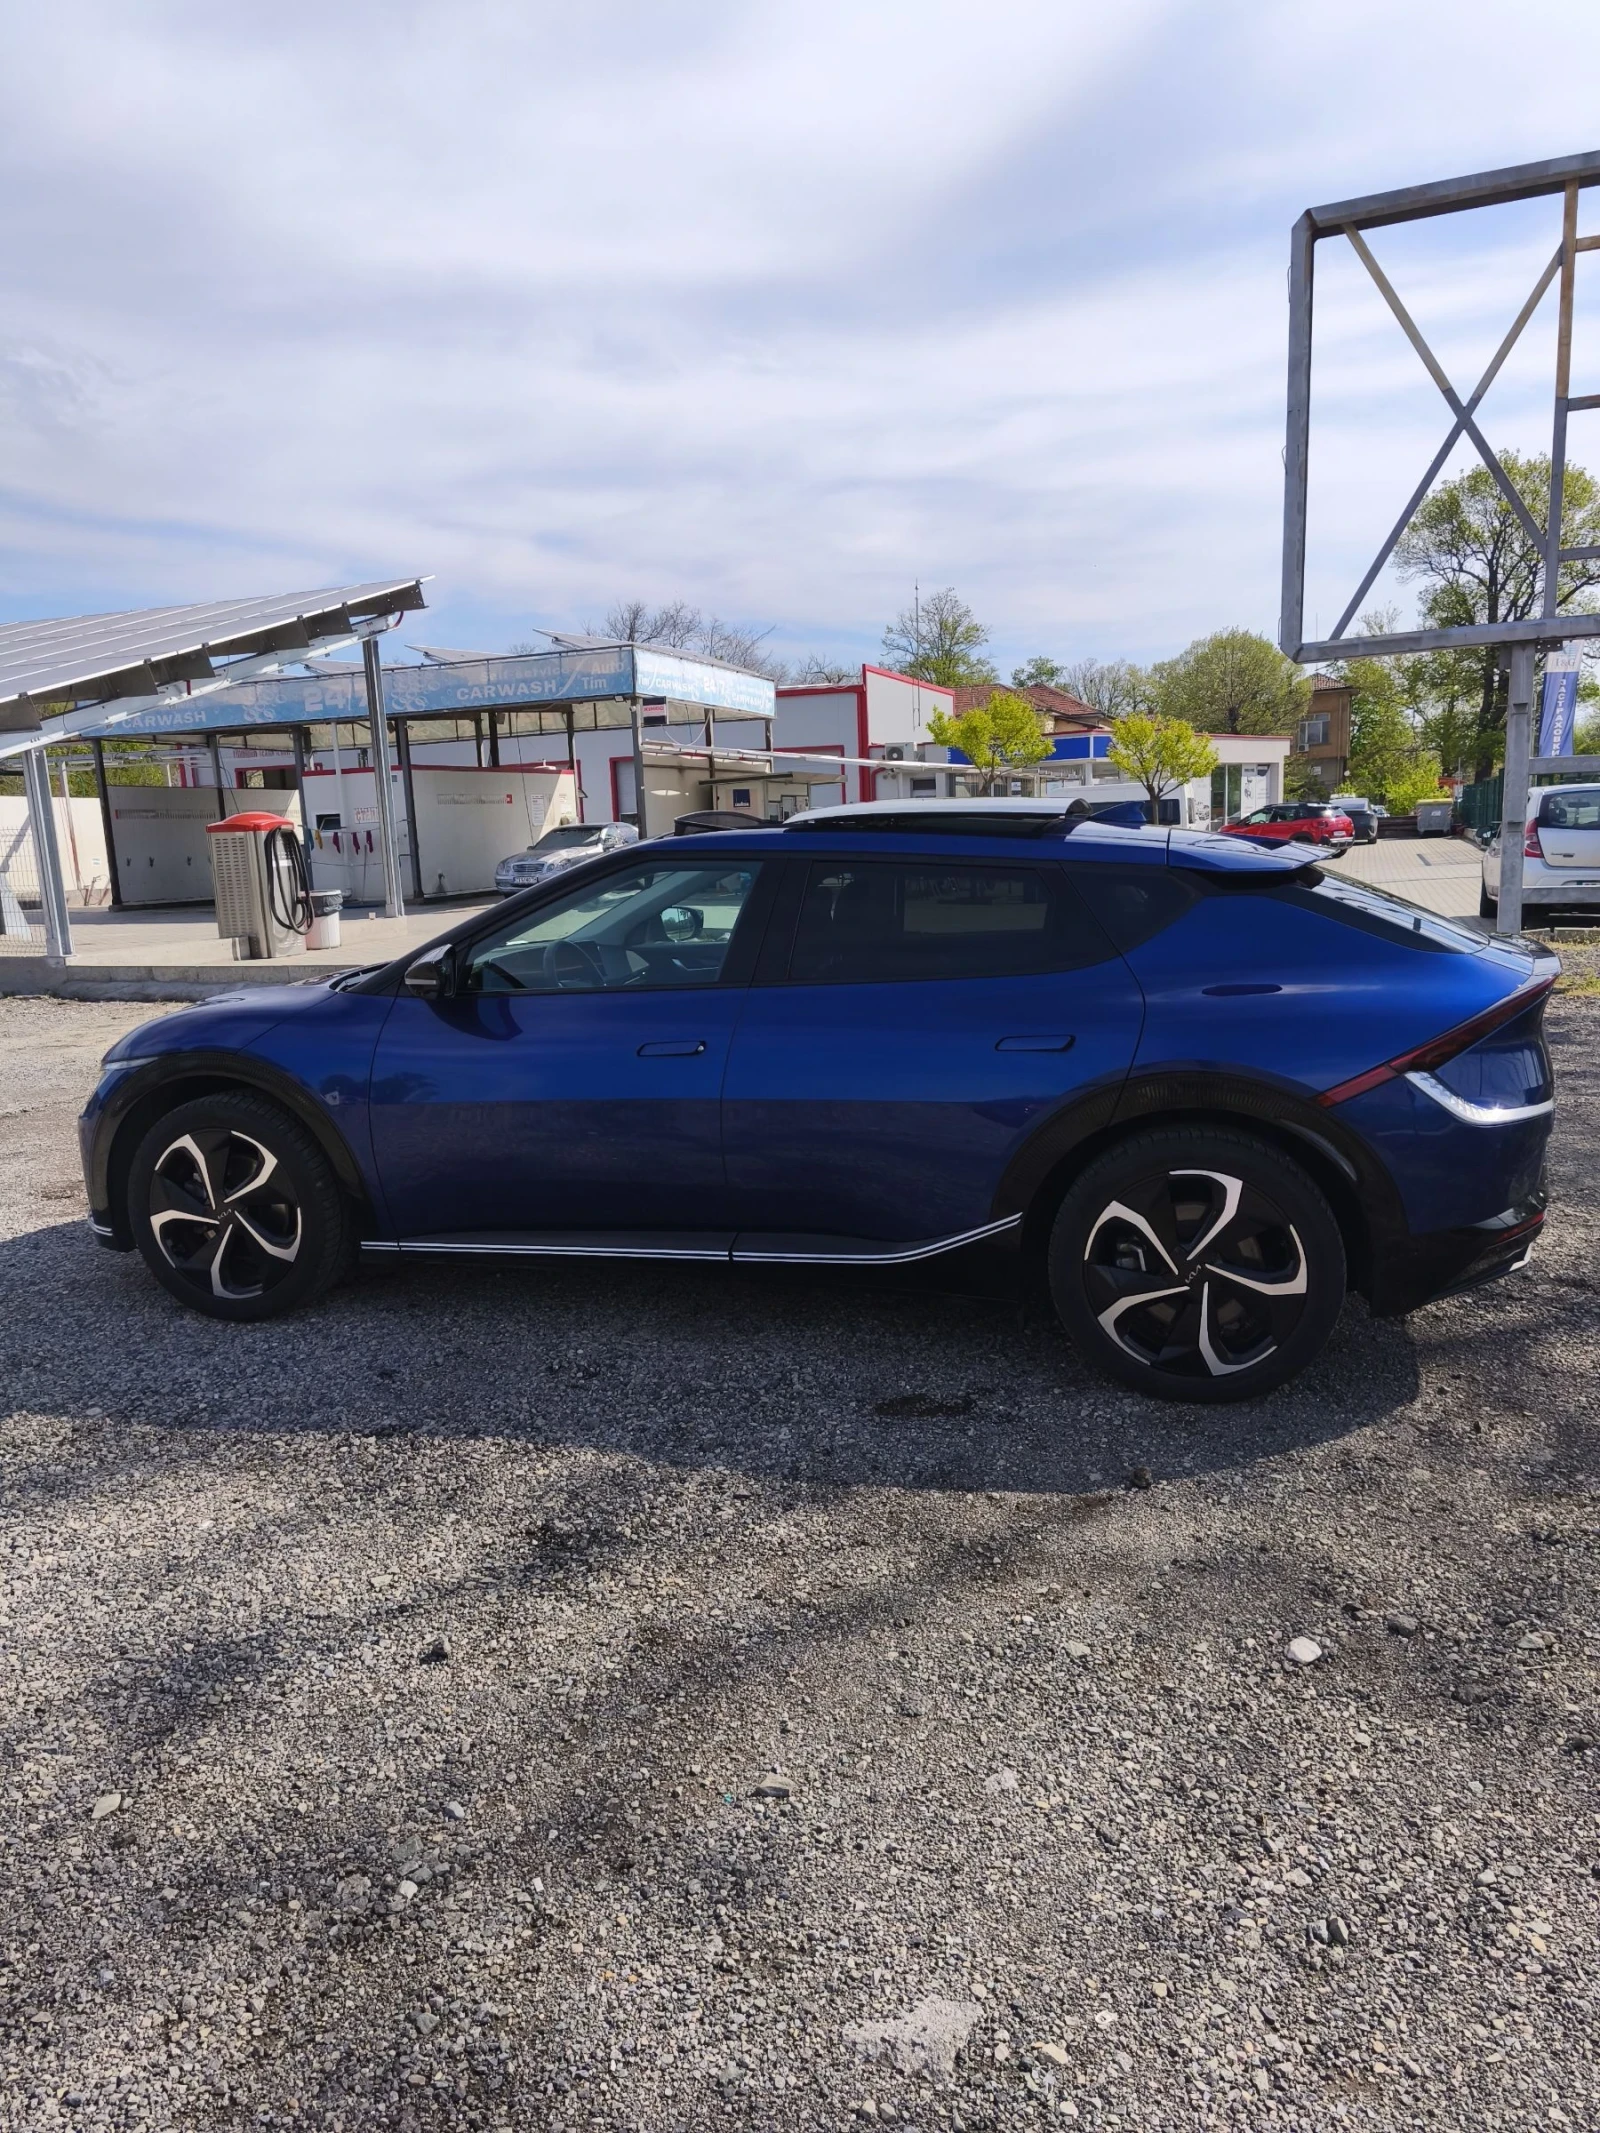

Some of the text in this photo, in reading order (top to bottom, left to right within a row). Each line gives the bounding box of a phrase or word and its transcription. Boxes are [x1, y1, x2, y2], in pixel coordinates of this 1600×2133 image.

[456, 679, 556, 701] CARWASH
[581, 676, 607, 690] Tim
[656, 678, 693, 693] CARWASH
[122, 710, 206, 728] CARWASH
